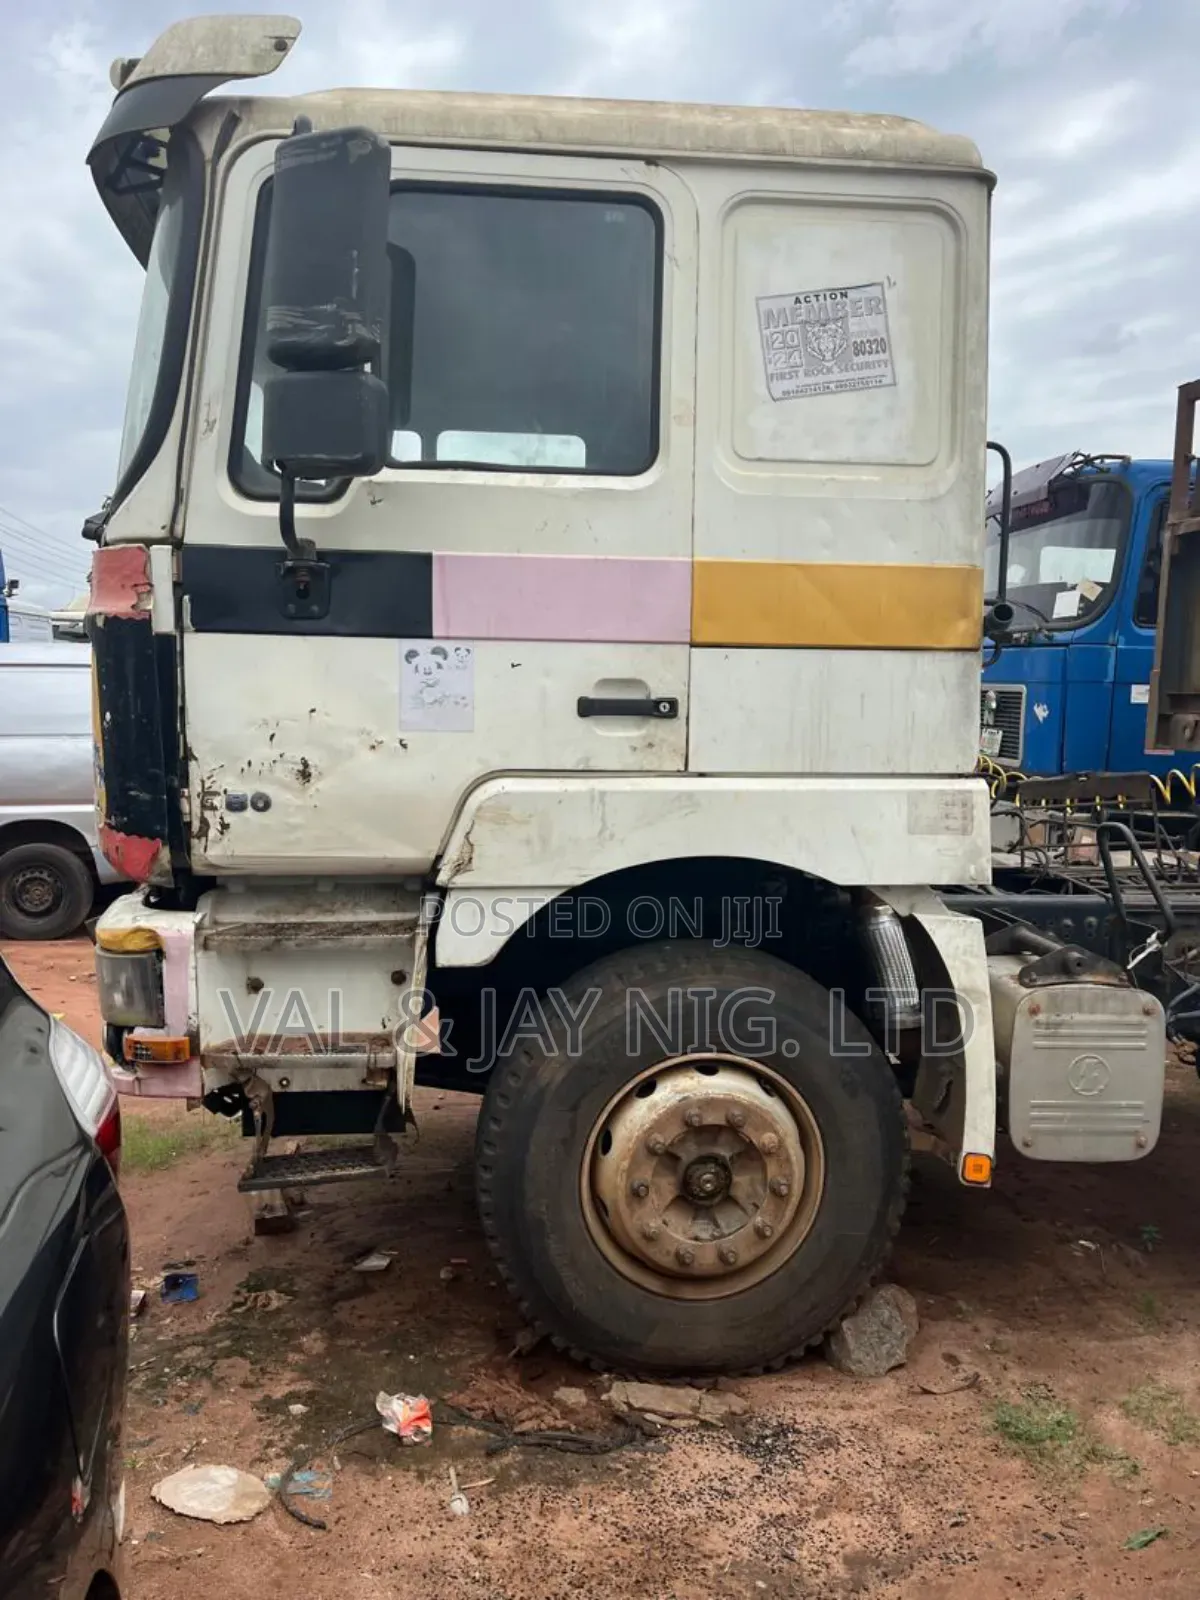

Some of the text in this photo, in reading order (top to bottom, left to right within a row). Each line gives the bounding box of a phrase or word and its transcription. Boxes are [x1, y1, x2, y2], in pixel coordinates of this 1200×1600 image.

[794, 291, 849, 305] ACTION
[763, 296, 885, 330] MEMBER
[772, 331, 799, 350] 20
[852, 337, 887, 358] 80320
[770, 370, 800, 382] FIRST
[804, 364, 834, 378] ROCK
[837, 359, 889, 374] SECURITY
